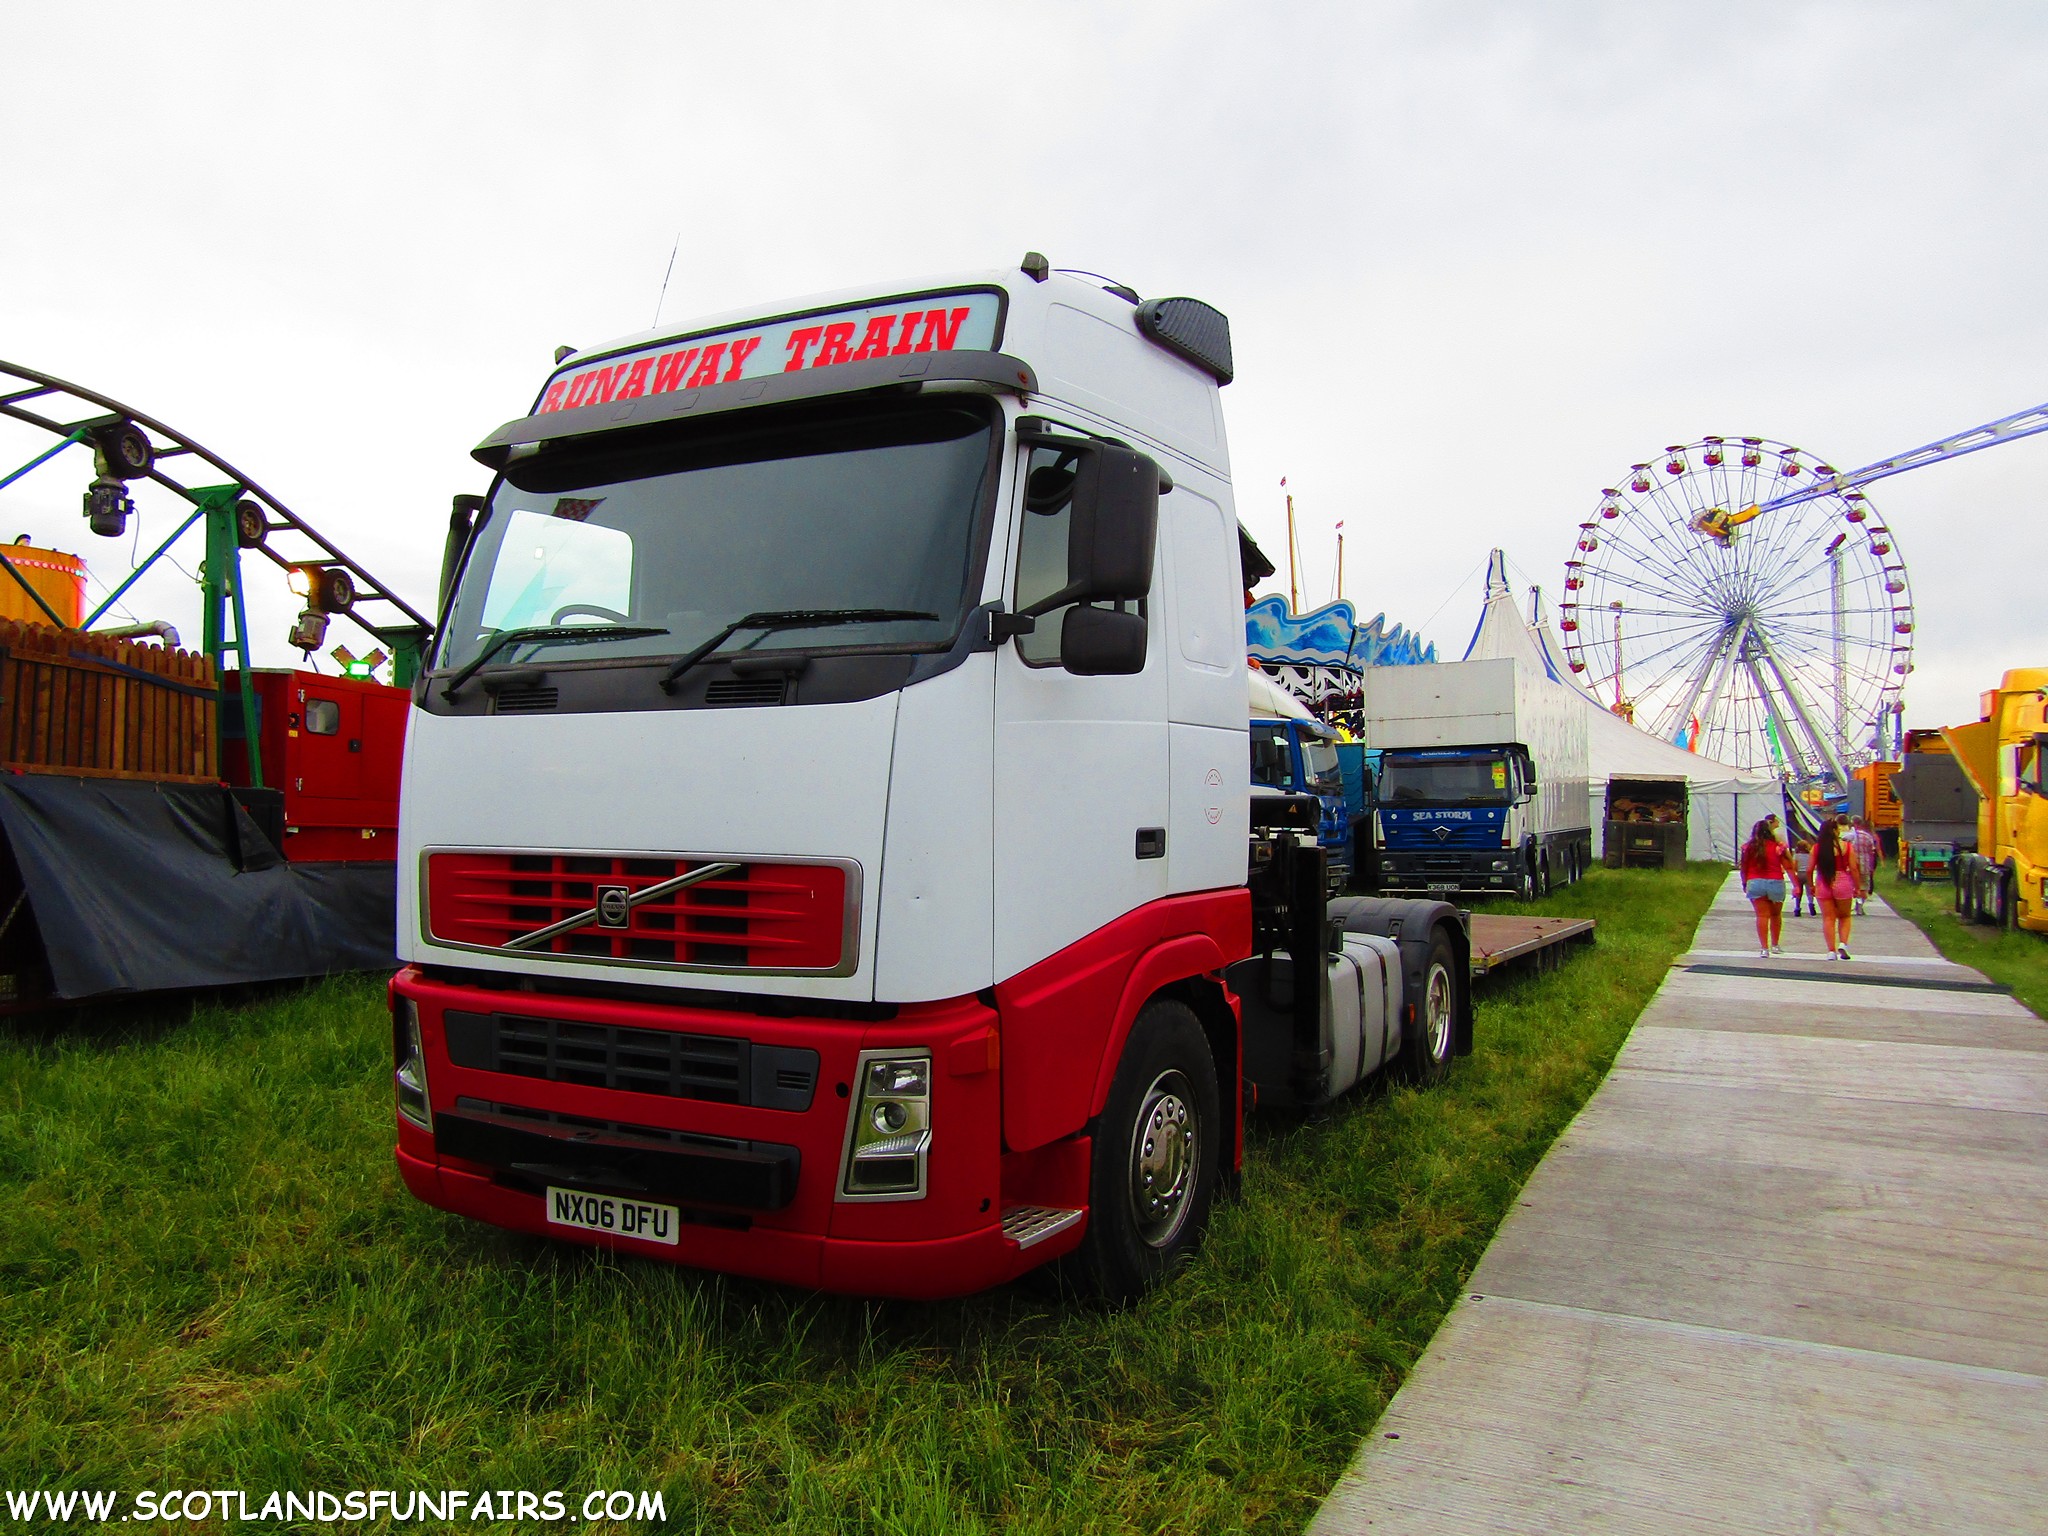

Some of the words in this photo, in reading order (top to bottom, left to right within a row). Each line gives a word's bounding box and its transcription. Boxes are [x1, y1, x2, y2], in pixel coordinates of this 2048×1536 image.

[540, 336, 761, 415] RUNAWAY
[785, 306, 970, 373] TRAIN
[1412, 811, 1433, 821] SEA
[1435, 811, 1472, 820] STORM
[555, 1192, 615, 1229] NX06
[621, 1203, 669, 1238] DFU
